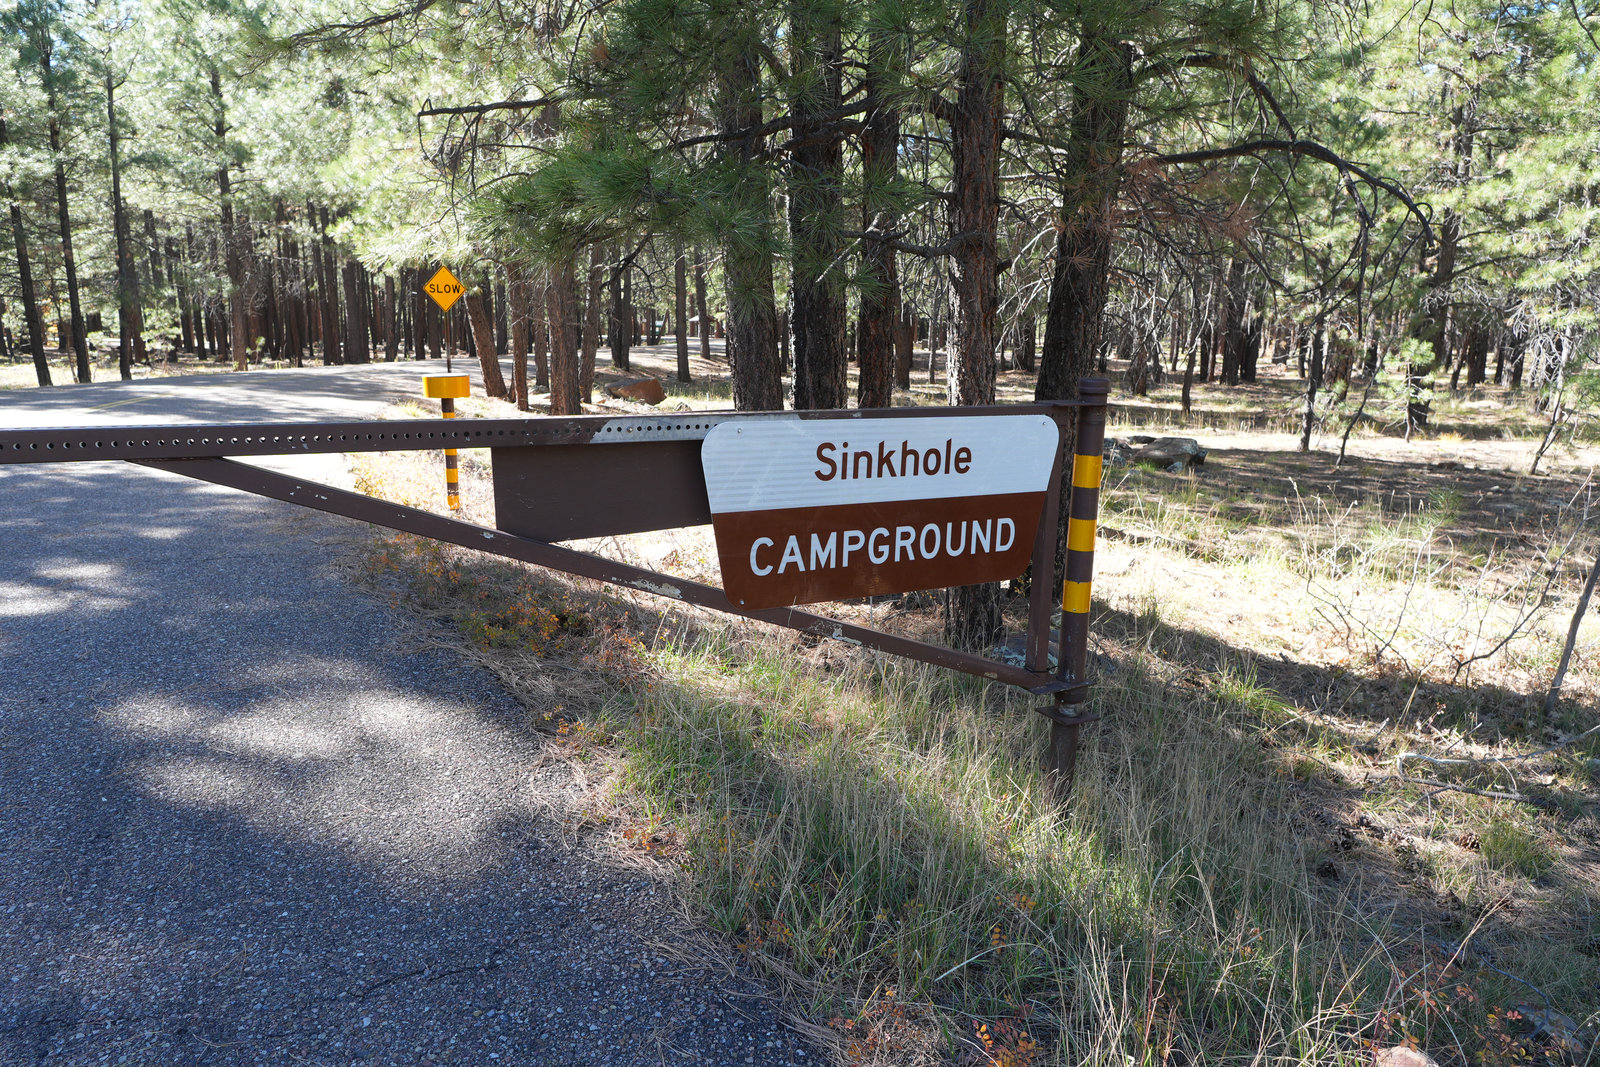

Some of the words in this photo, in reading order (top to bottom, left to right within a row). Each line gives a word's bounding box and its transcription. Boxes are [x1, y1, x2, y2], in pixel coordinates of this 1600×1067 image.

[429, 284, 461, 294] SLOW
[814, 438, 972, 482] Sinkhole
[749, 517, 1016, 577] CAMPGROUND
